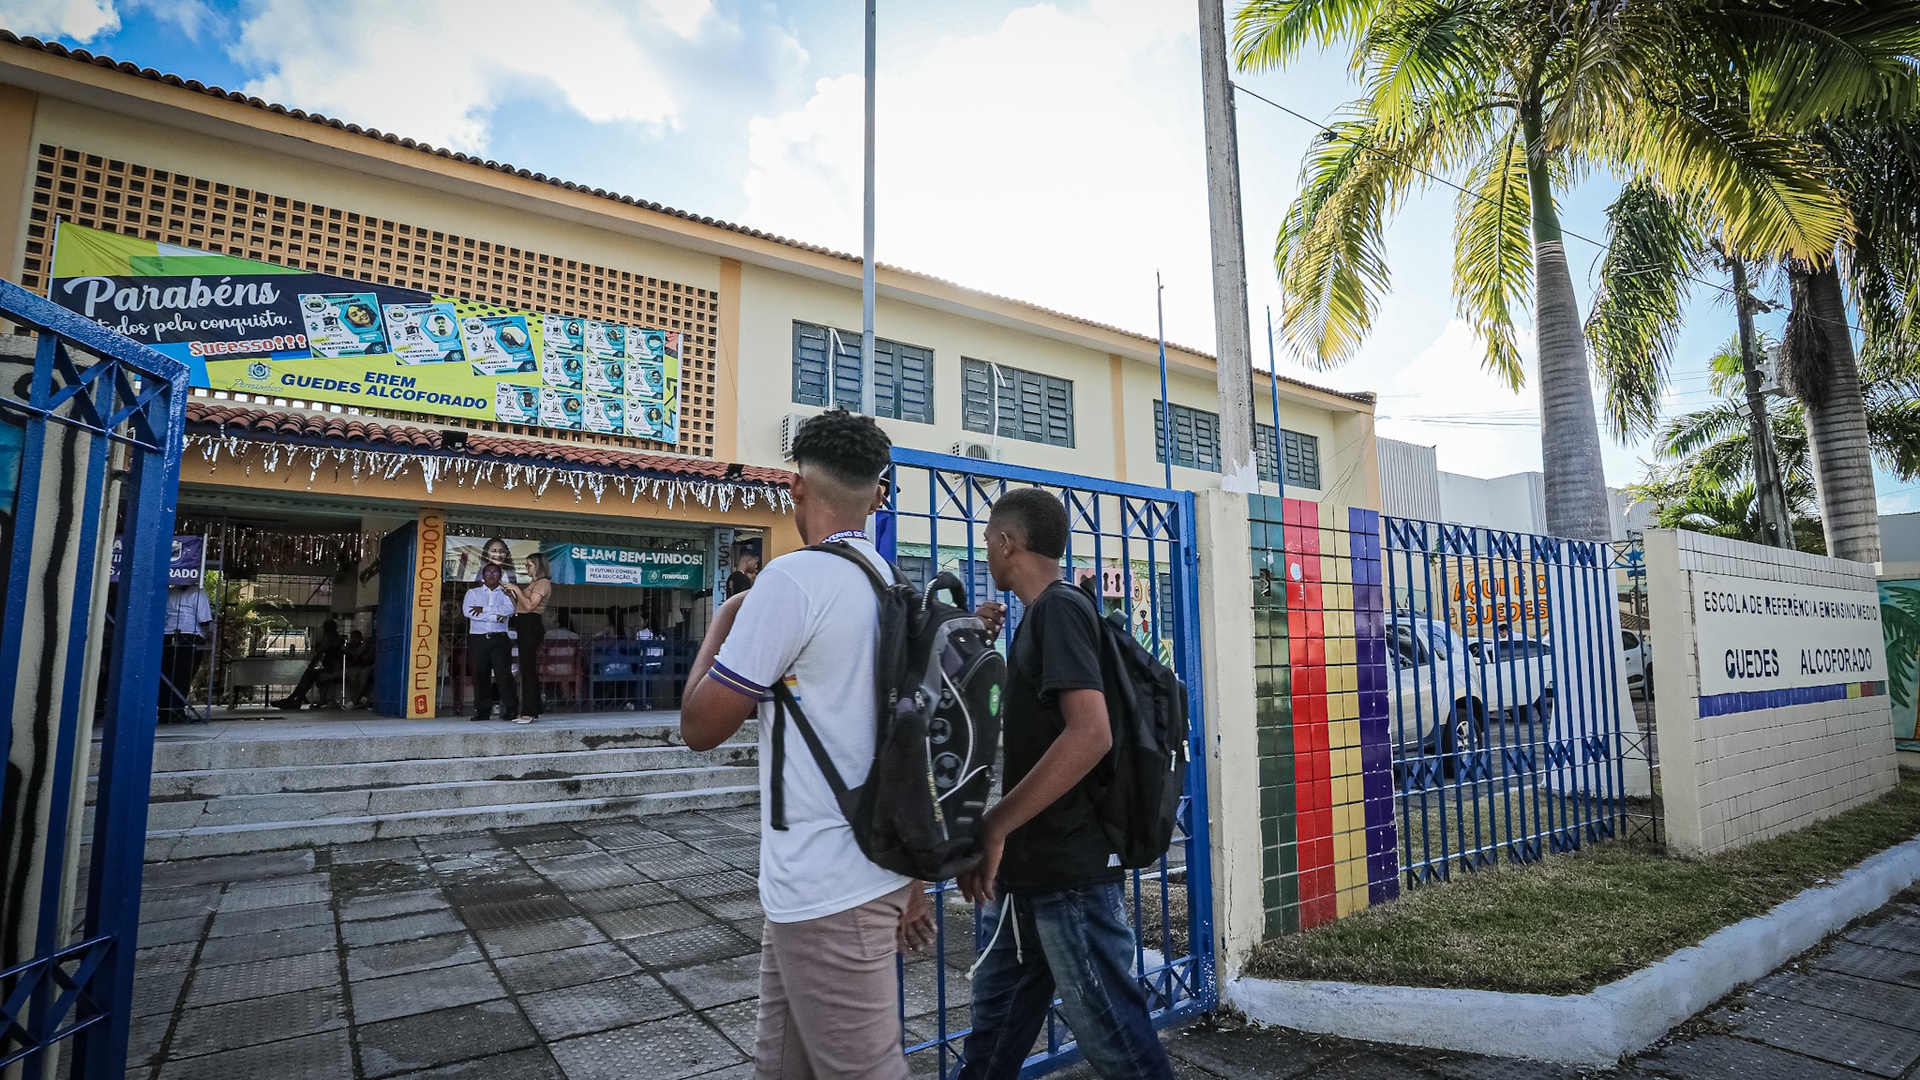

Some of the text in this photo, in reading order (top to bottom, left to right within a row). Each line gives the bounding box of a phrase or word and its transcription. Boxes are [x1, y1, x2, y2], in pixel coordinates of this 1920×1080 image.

[63, 276, 280, 317] Parabéns
[154, 312, 197, 342] pela
[200, 309, 293, 336] conquista.
[189, 334, 307, 357] Sucesso!!!
[281, 373, 488, 410] GUEDES ALCOFORADO
[364, 371, 416, 388] EREM
[571, 547, 703, 565] SEJAM BEM-VINDOS!
[718, 532, 730, 606] ESPIRI
[414, 515, 441, 691] CORPOREIDADE
[1464, 598, 1550, 626] GUEDES
[1704, 591, 1749, 614] ESCOLA
[1750, 595, 1763, 615] DE
[1819, 601, 1831, 619] EM
[1831, 602, 1856, 620] ENSINO
[1725, 647, 1873, 679] GUEDES ALCOFORADO
